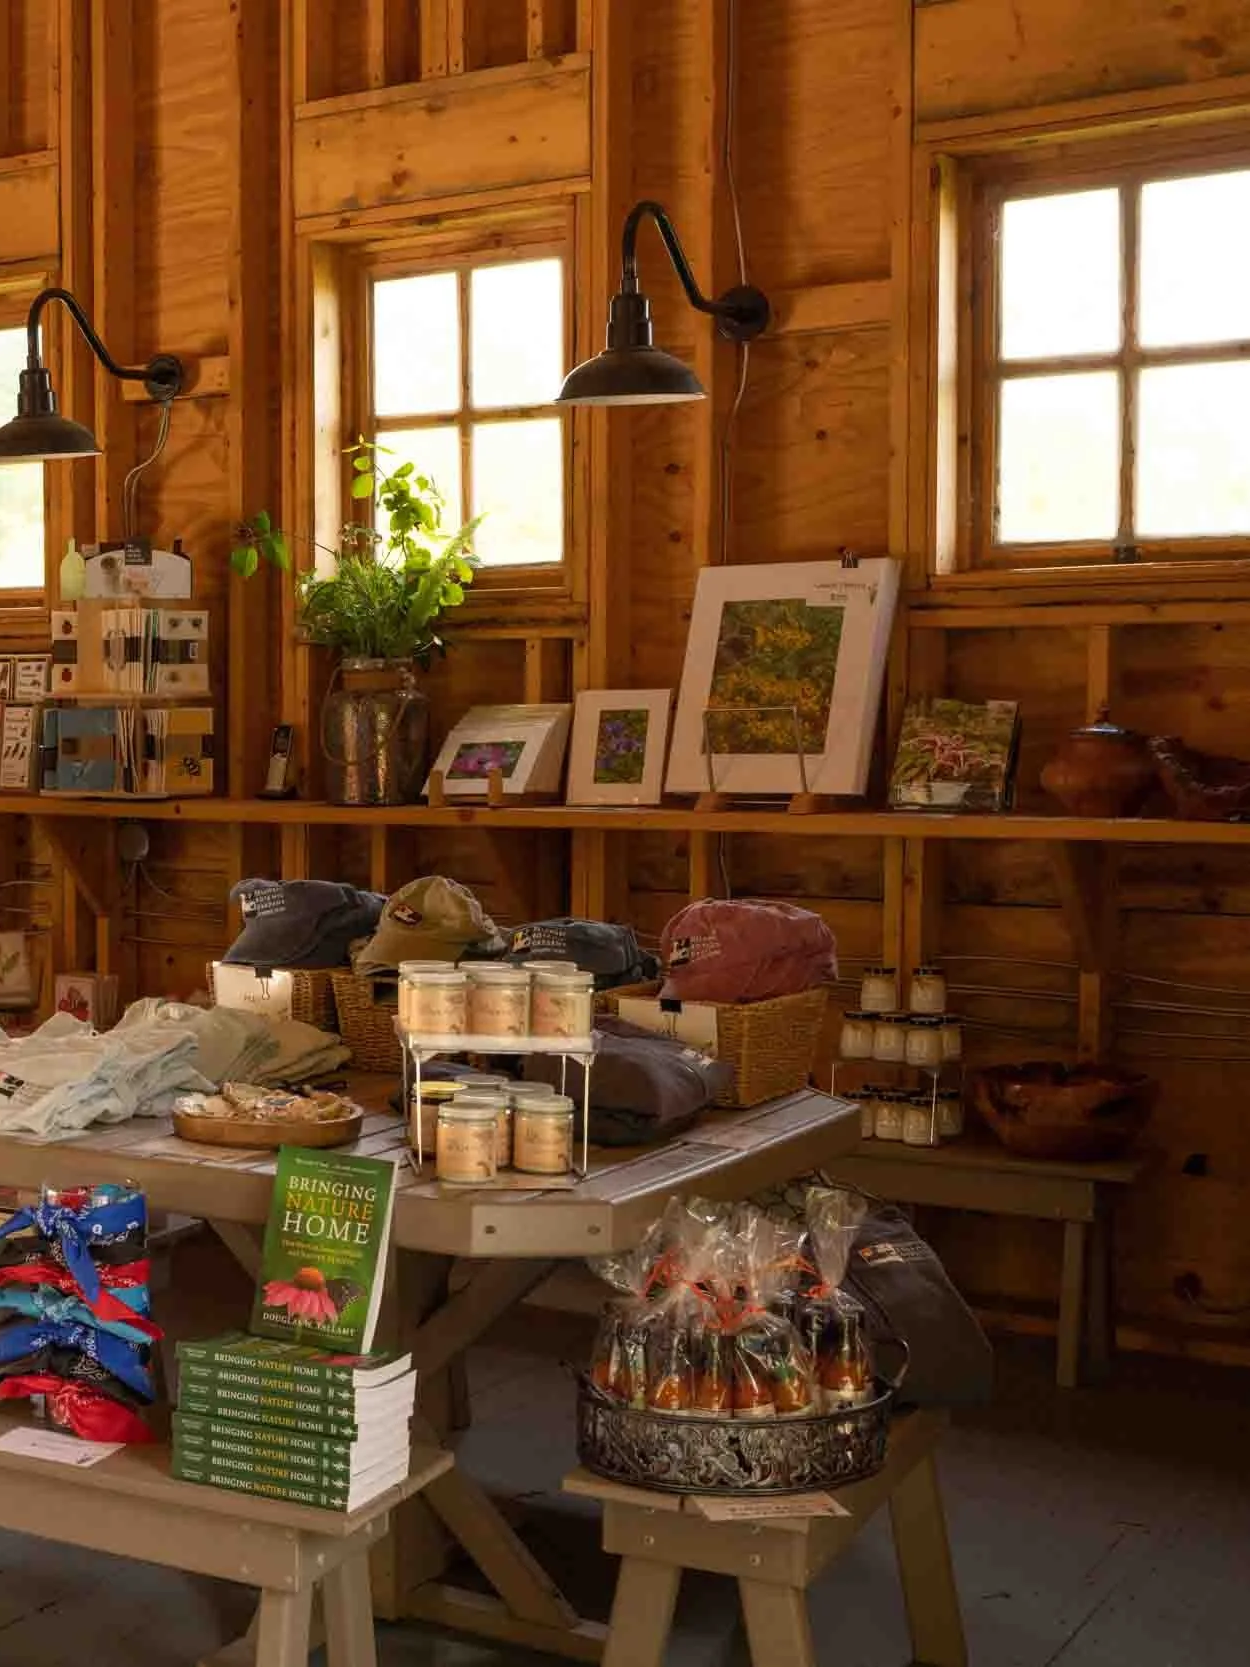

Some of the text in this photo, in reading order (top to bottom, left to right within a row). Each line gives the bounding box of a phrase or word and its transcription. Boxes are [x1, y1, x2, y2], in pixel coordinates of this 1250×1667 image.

[288, 1175, 377, 1201] BRINGING
[285, 1191, 375, 1221] NATURE
[282, 1211, 370, 1245] HOME
[214, 1352, 319, 1378] BRINGING NATURE HOME
[217, 1371, 321, 1395] BRINGING NATURE HOME
[217, 1389, 321, 1414] BRINGING NATURE HOME
[217, 1407, 324, 1431] BRINGING NATURE HOME
[211, 1423, 317, 1450] BRINGING NATURE HOME
[211, 1439, 317, 1466] BRINGING NATURE HOME
[211, 1455, 316, 1484] BRINGING NATURE HOME
[210, 1474, 315, 1502] BRINGING NATURE HOME
